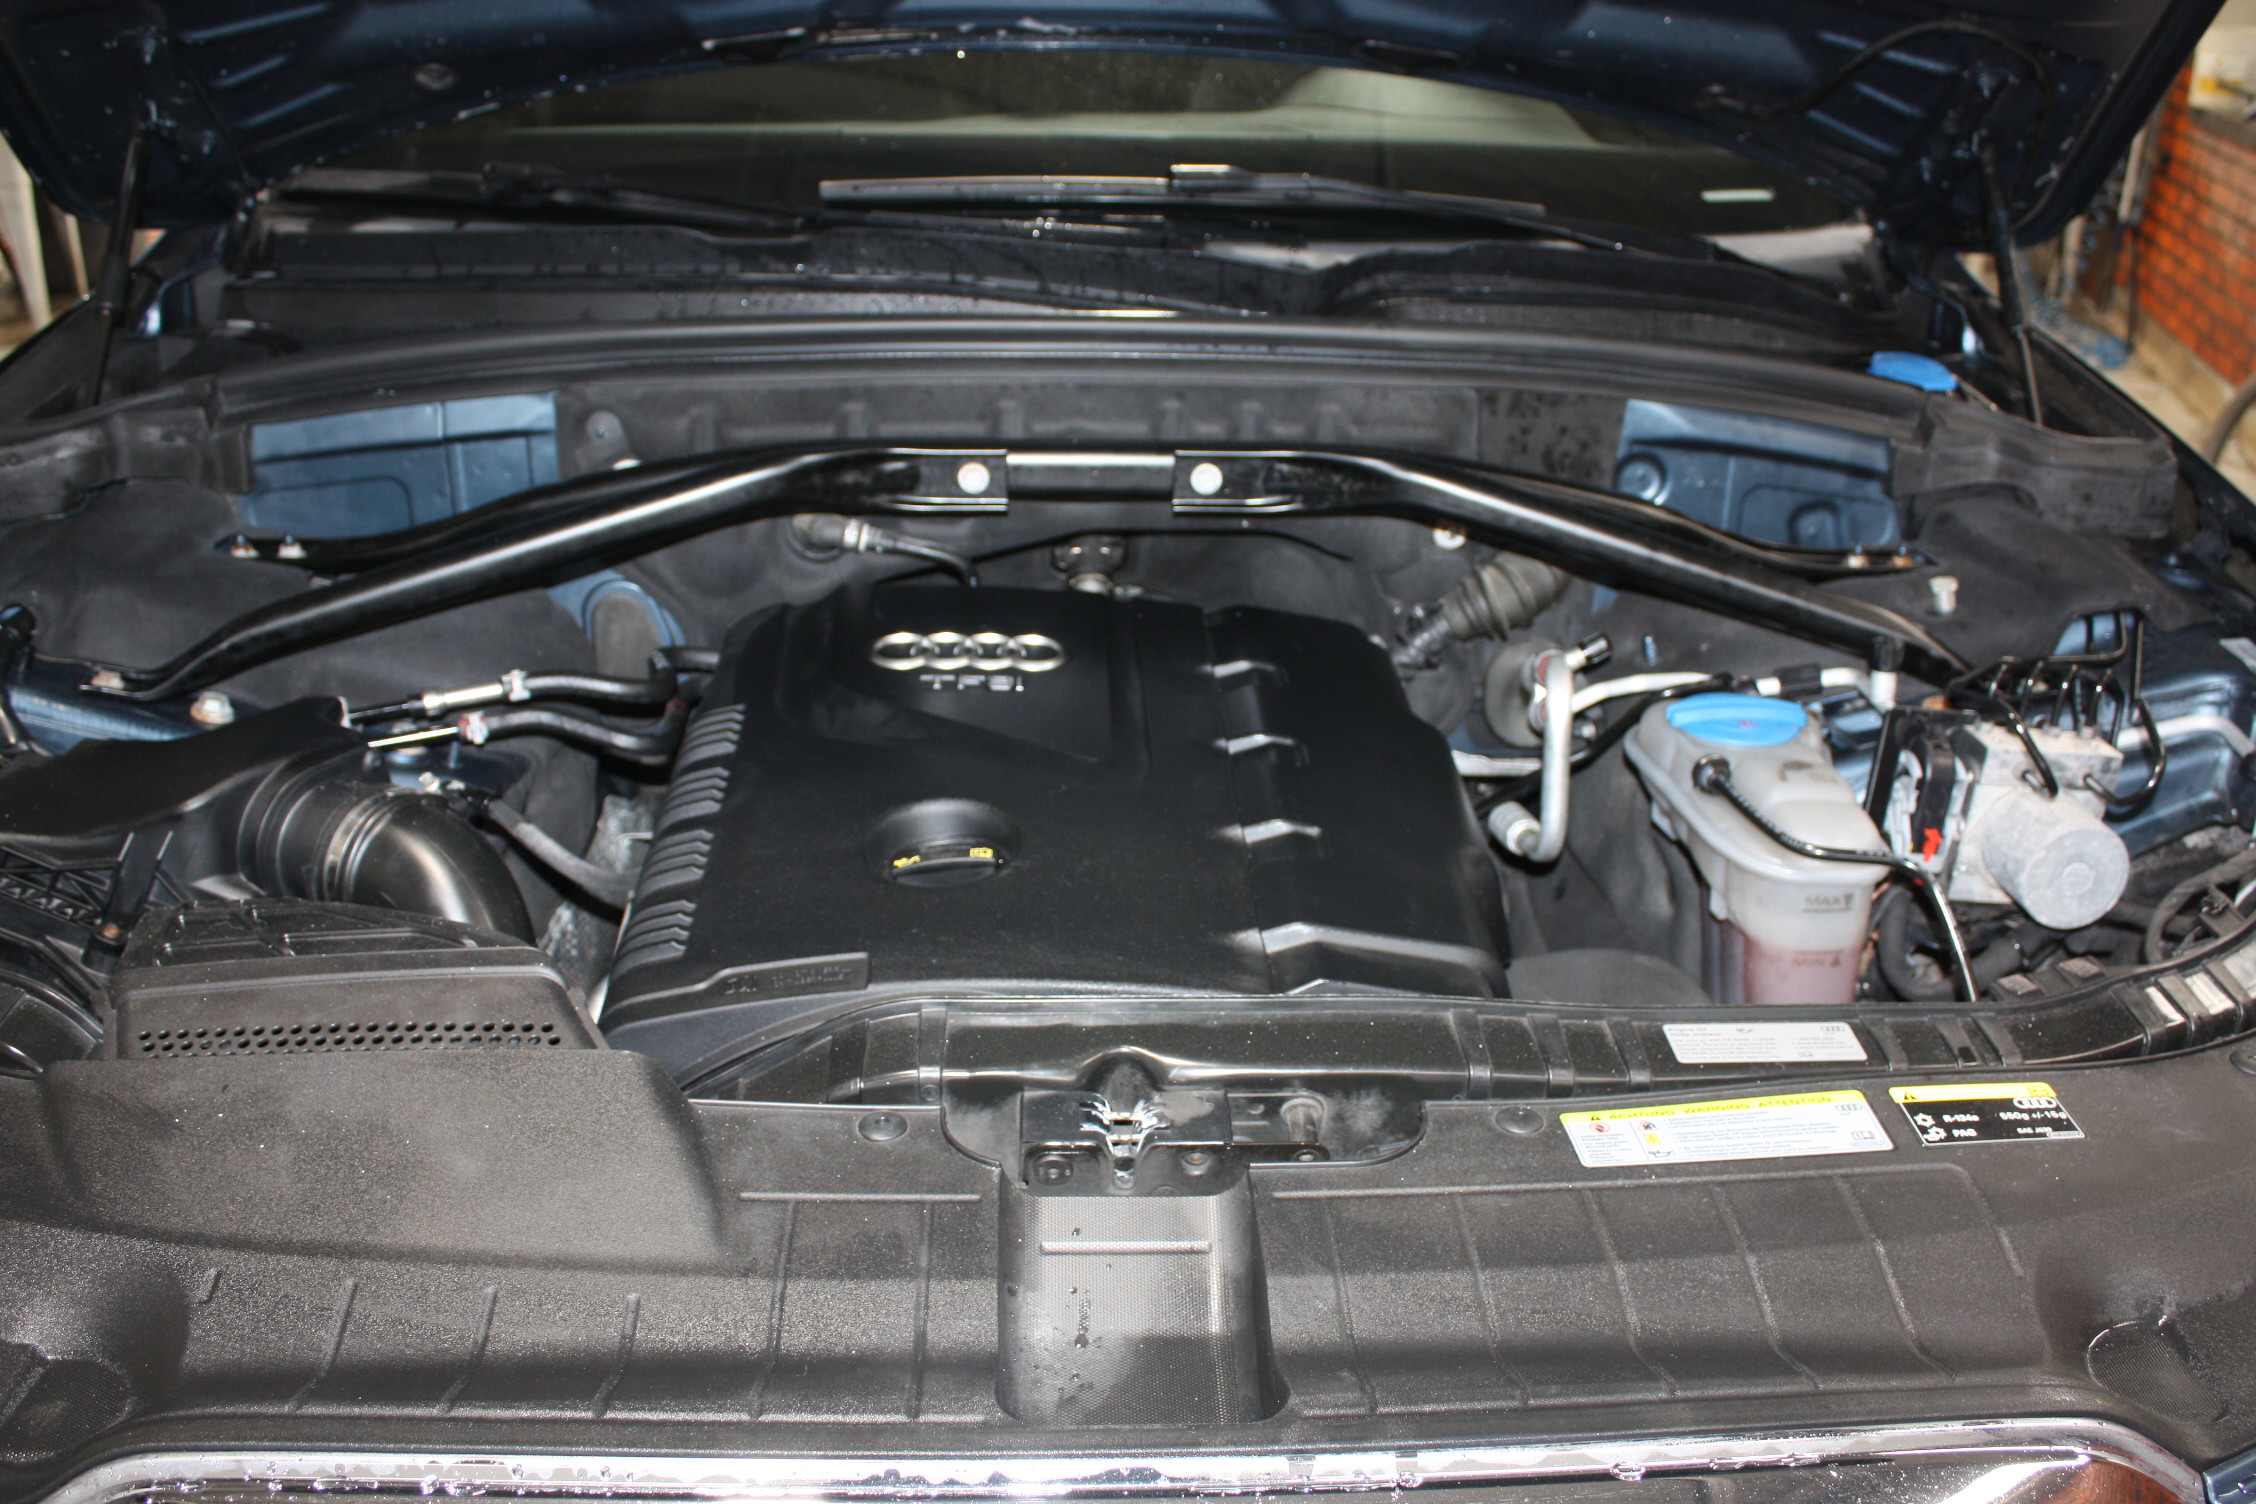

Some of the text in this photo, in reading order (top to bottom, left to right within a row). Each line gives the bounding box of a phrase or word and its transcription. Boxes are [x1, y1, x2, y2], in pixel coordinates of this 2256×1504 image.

[919, 674, 1025, 692] TFSI
[1804, 895, 1841, 905] MAX
[1791, 957, 1825, 967] MIN
[1609, 1096, 1832, 1119] ACHTUNG WARNING ATTENTION
